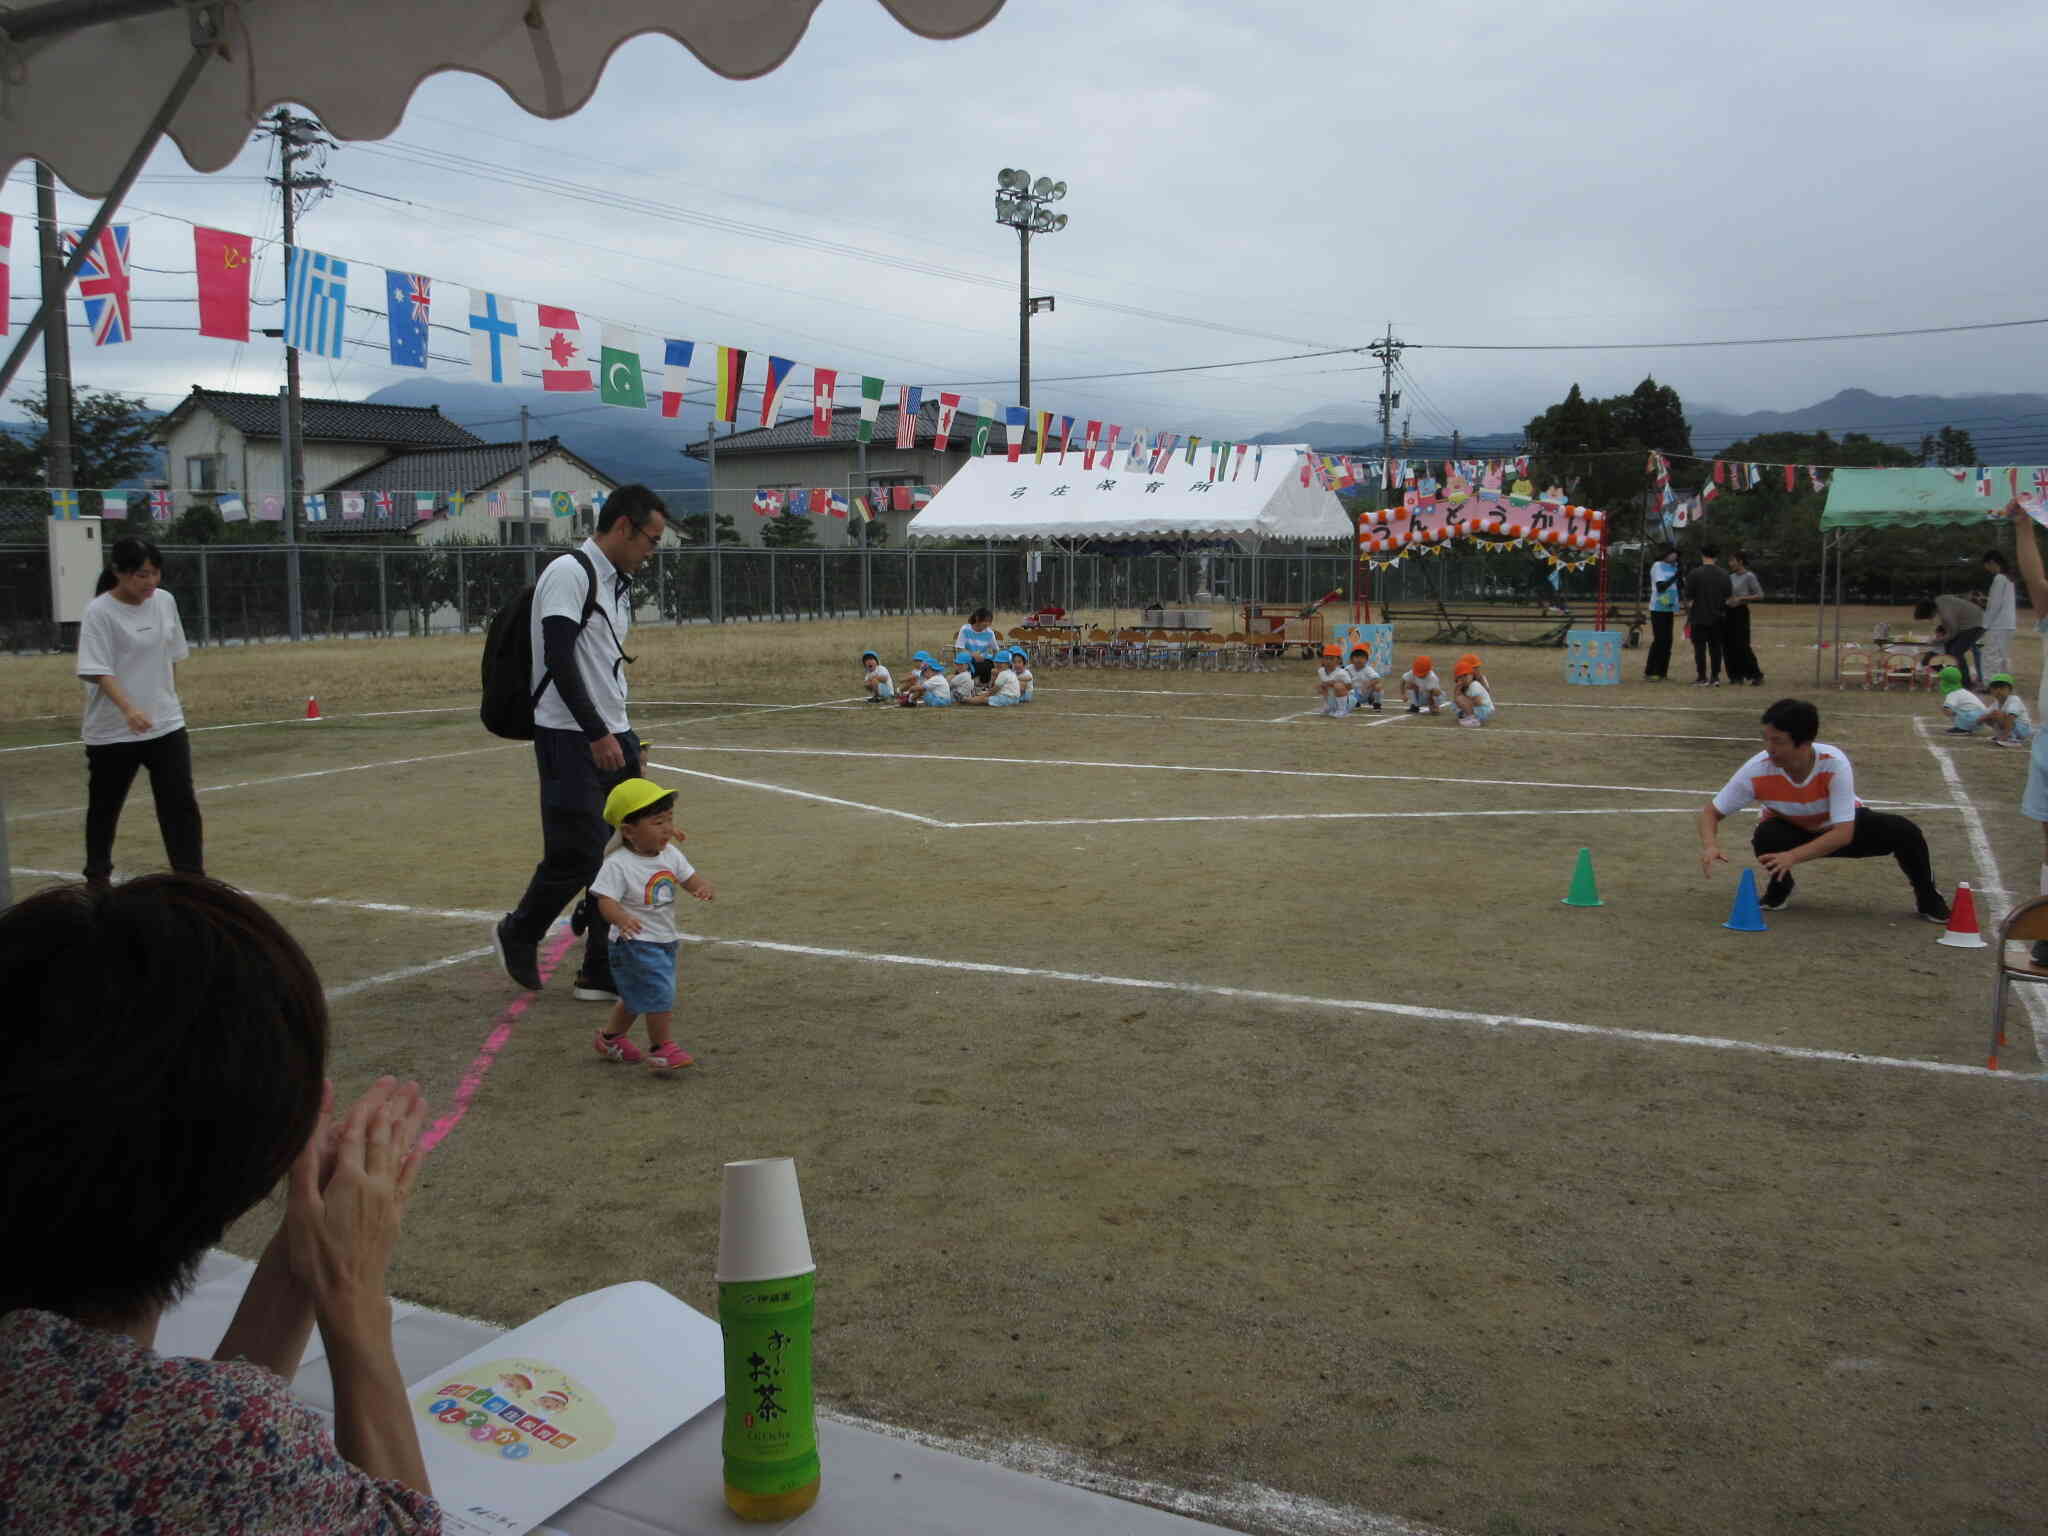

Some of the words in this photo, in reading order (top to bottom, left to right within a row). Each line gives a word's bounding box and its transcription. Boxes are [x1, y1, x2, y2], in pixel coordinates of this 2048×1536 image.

[1372, 504, 1590, 540] うんどうかい
[747, 1351, 788, 1423] お茶
